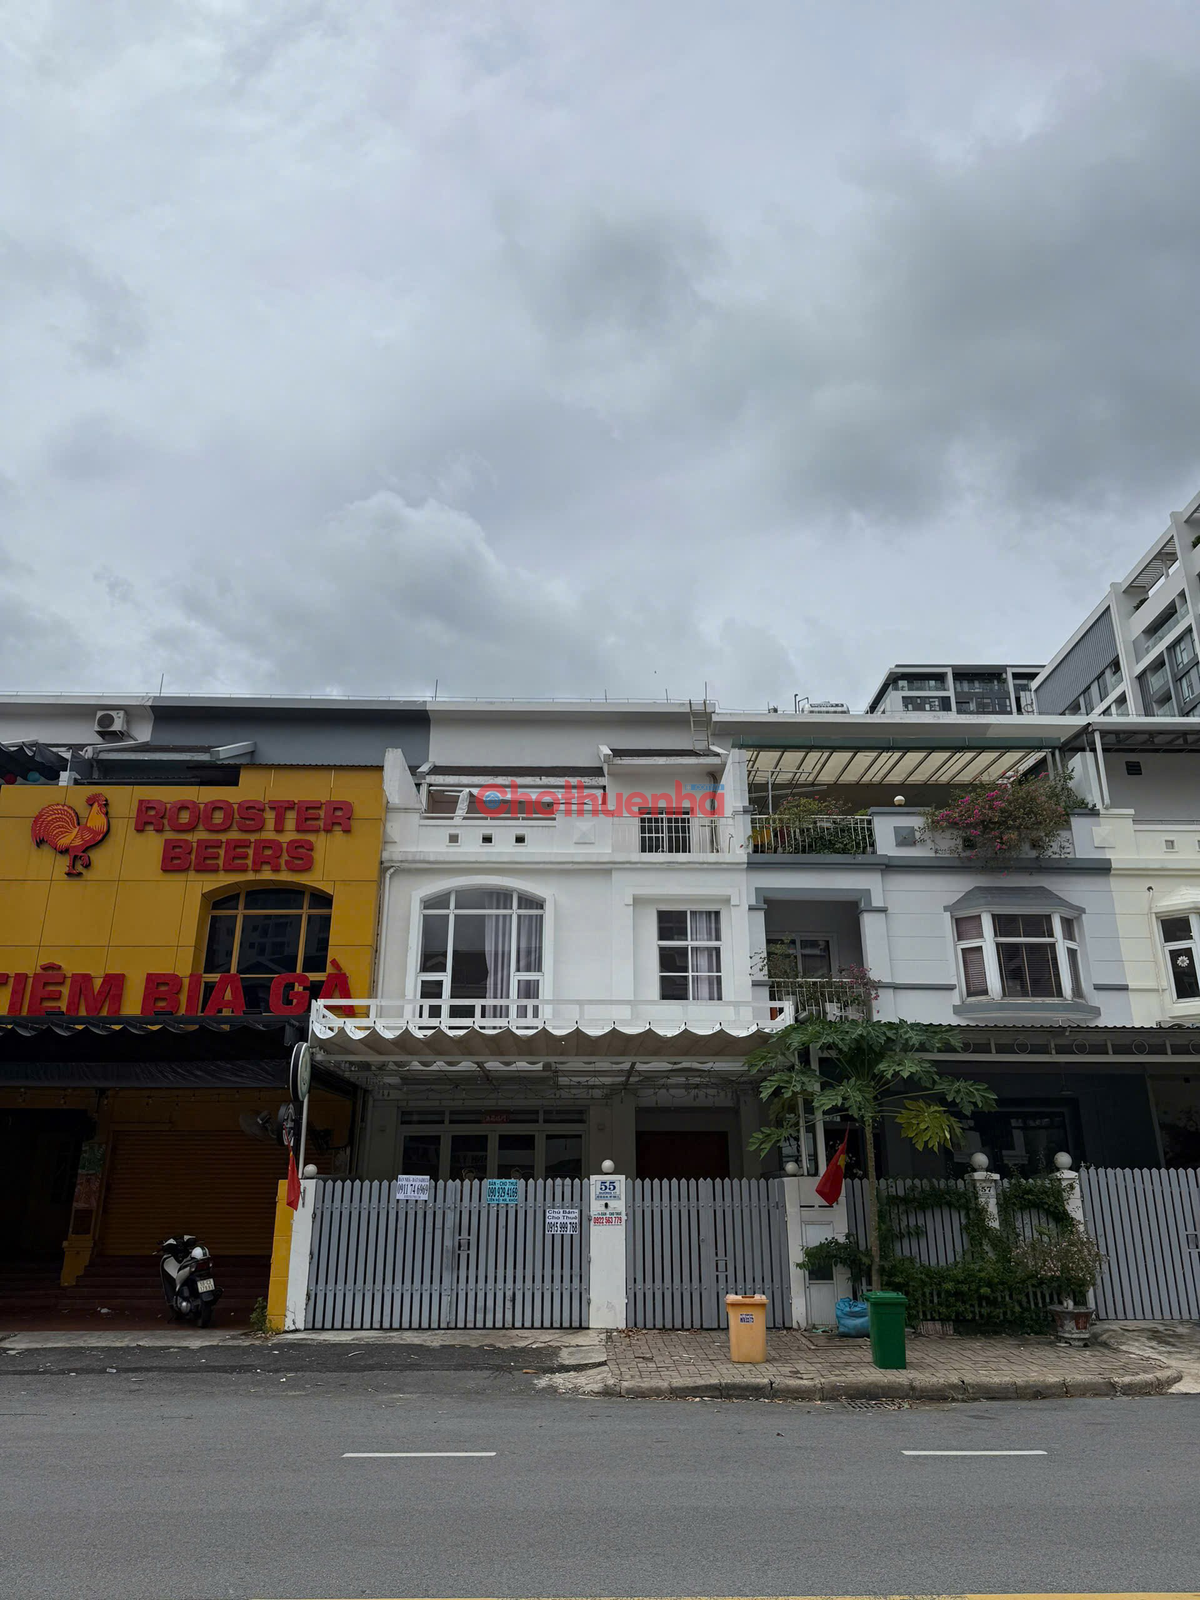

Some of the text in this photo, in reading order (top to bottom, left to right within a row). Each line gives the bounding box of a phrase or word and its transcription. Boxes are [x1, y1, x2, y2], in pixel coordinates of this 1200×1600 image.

[134, 799, 354, 832] ROOSTER
[160, 838, 315, 871] BEERS
[140, 972, 246, 1016] BIA
[268, 957, 356, 1016] GÀ
[600, 1181, 616, 1191] 55
[547, 1221, 558, 1232] 0915
[559, 1221, 568, 1232] 999
